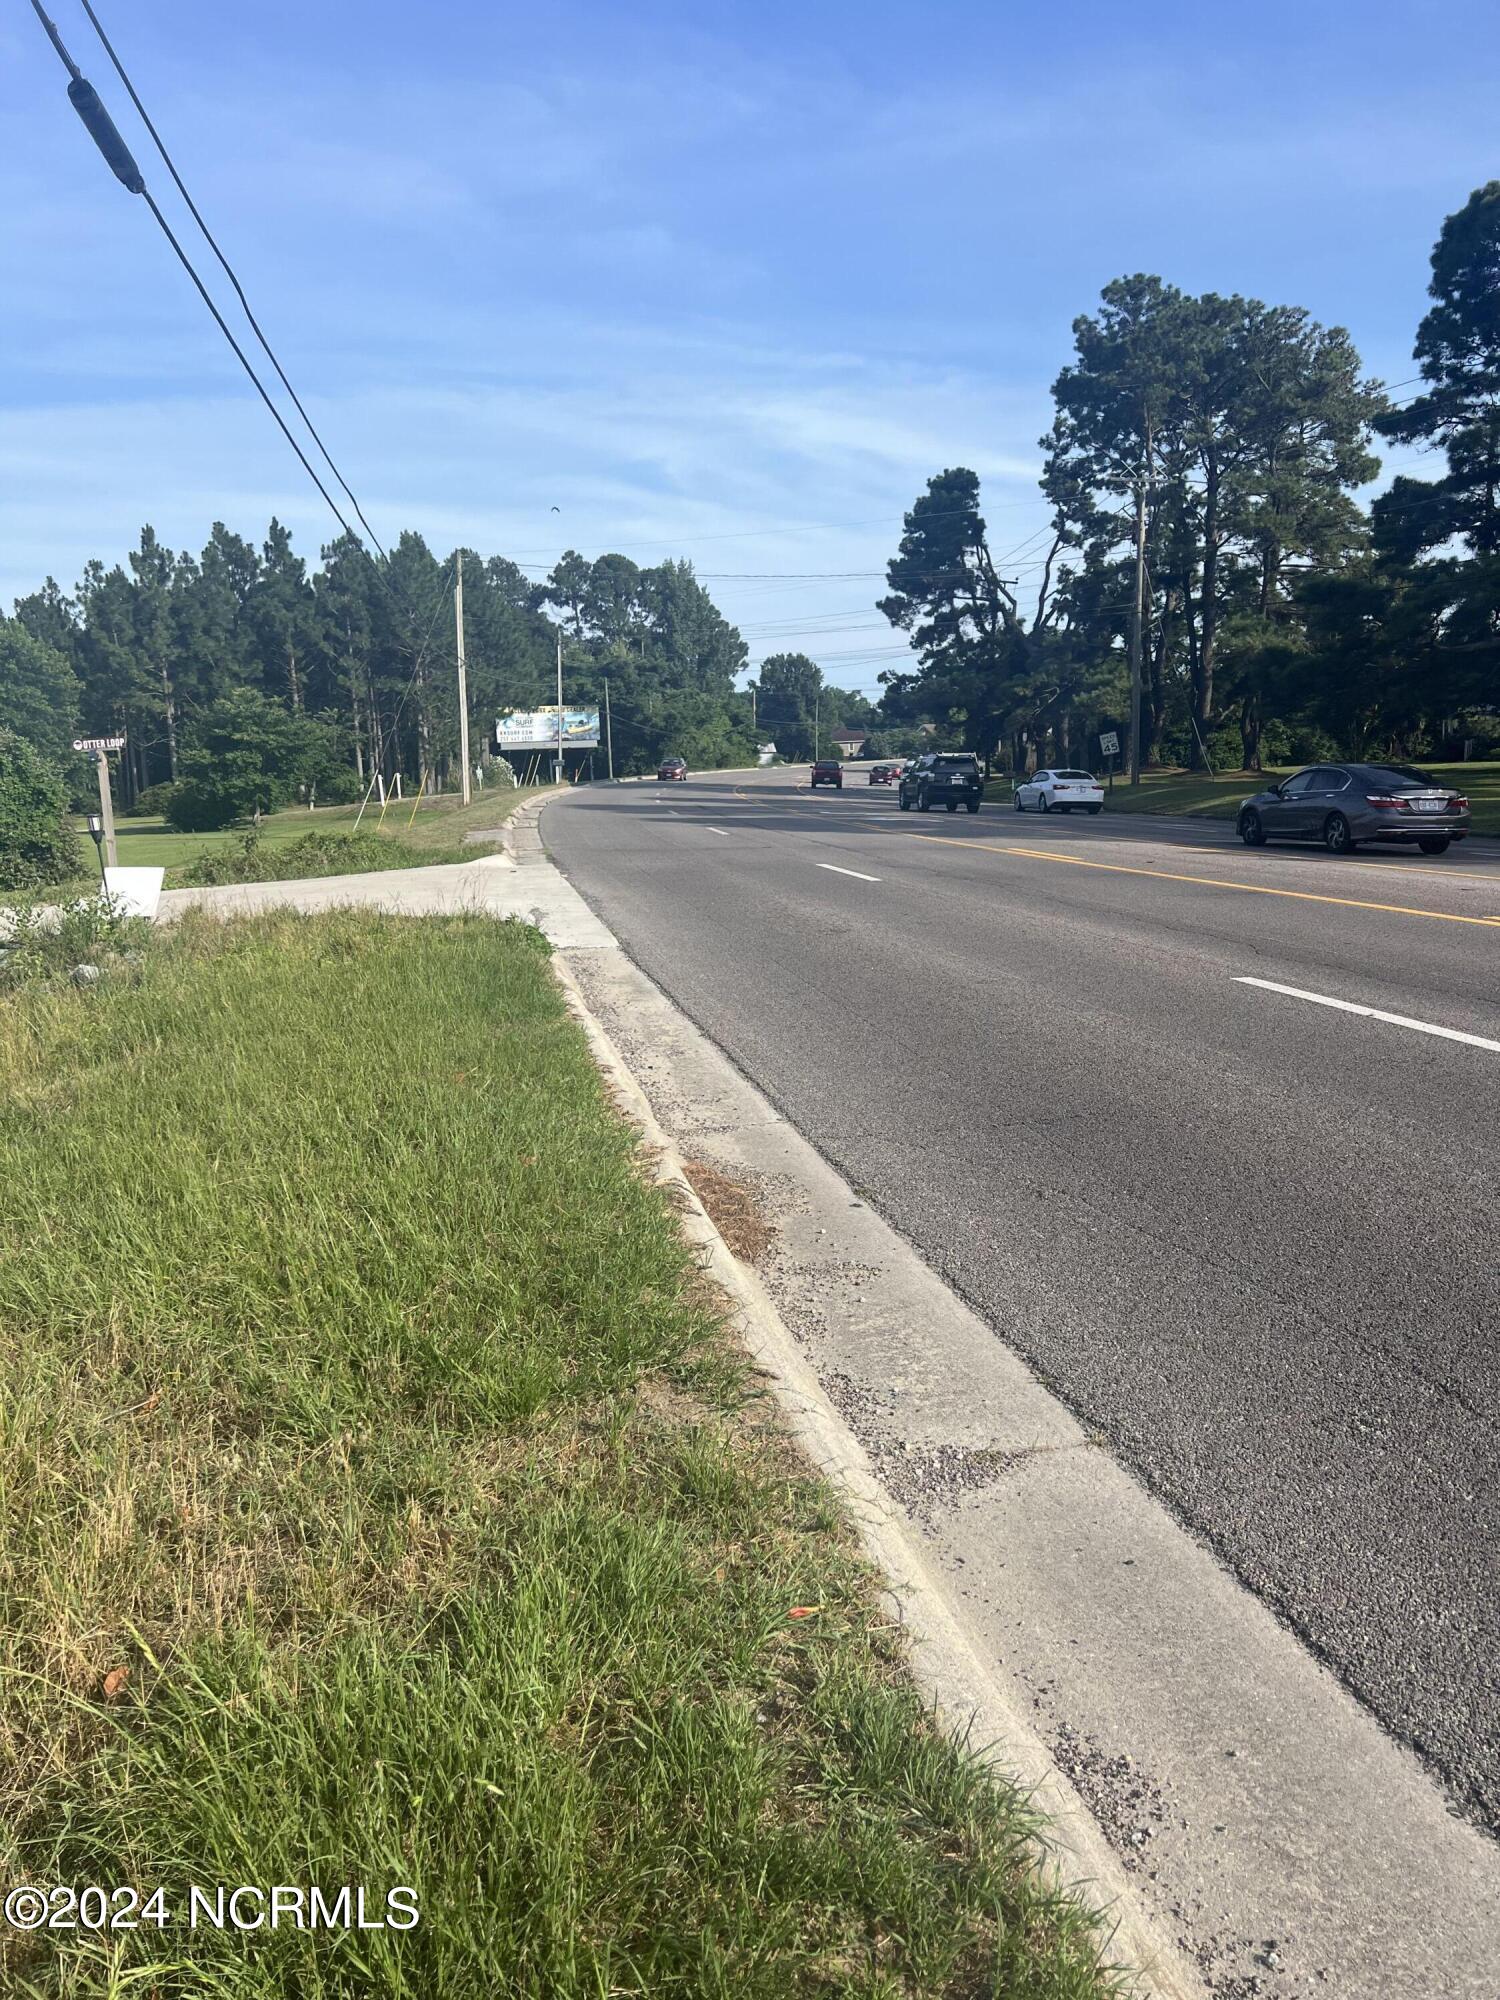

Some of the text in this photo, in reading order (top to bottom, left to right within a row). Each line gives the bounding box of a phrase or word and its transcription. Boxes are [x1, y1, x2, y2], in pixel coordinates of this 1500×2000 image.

[82, 737, 125, 749] OTTER LOOP
[1104, 742, 1118, 752] 45
